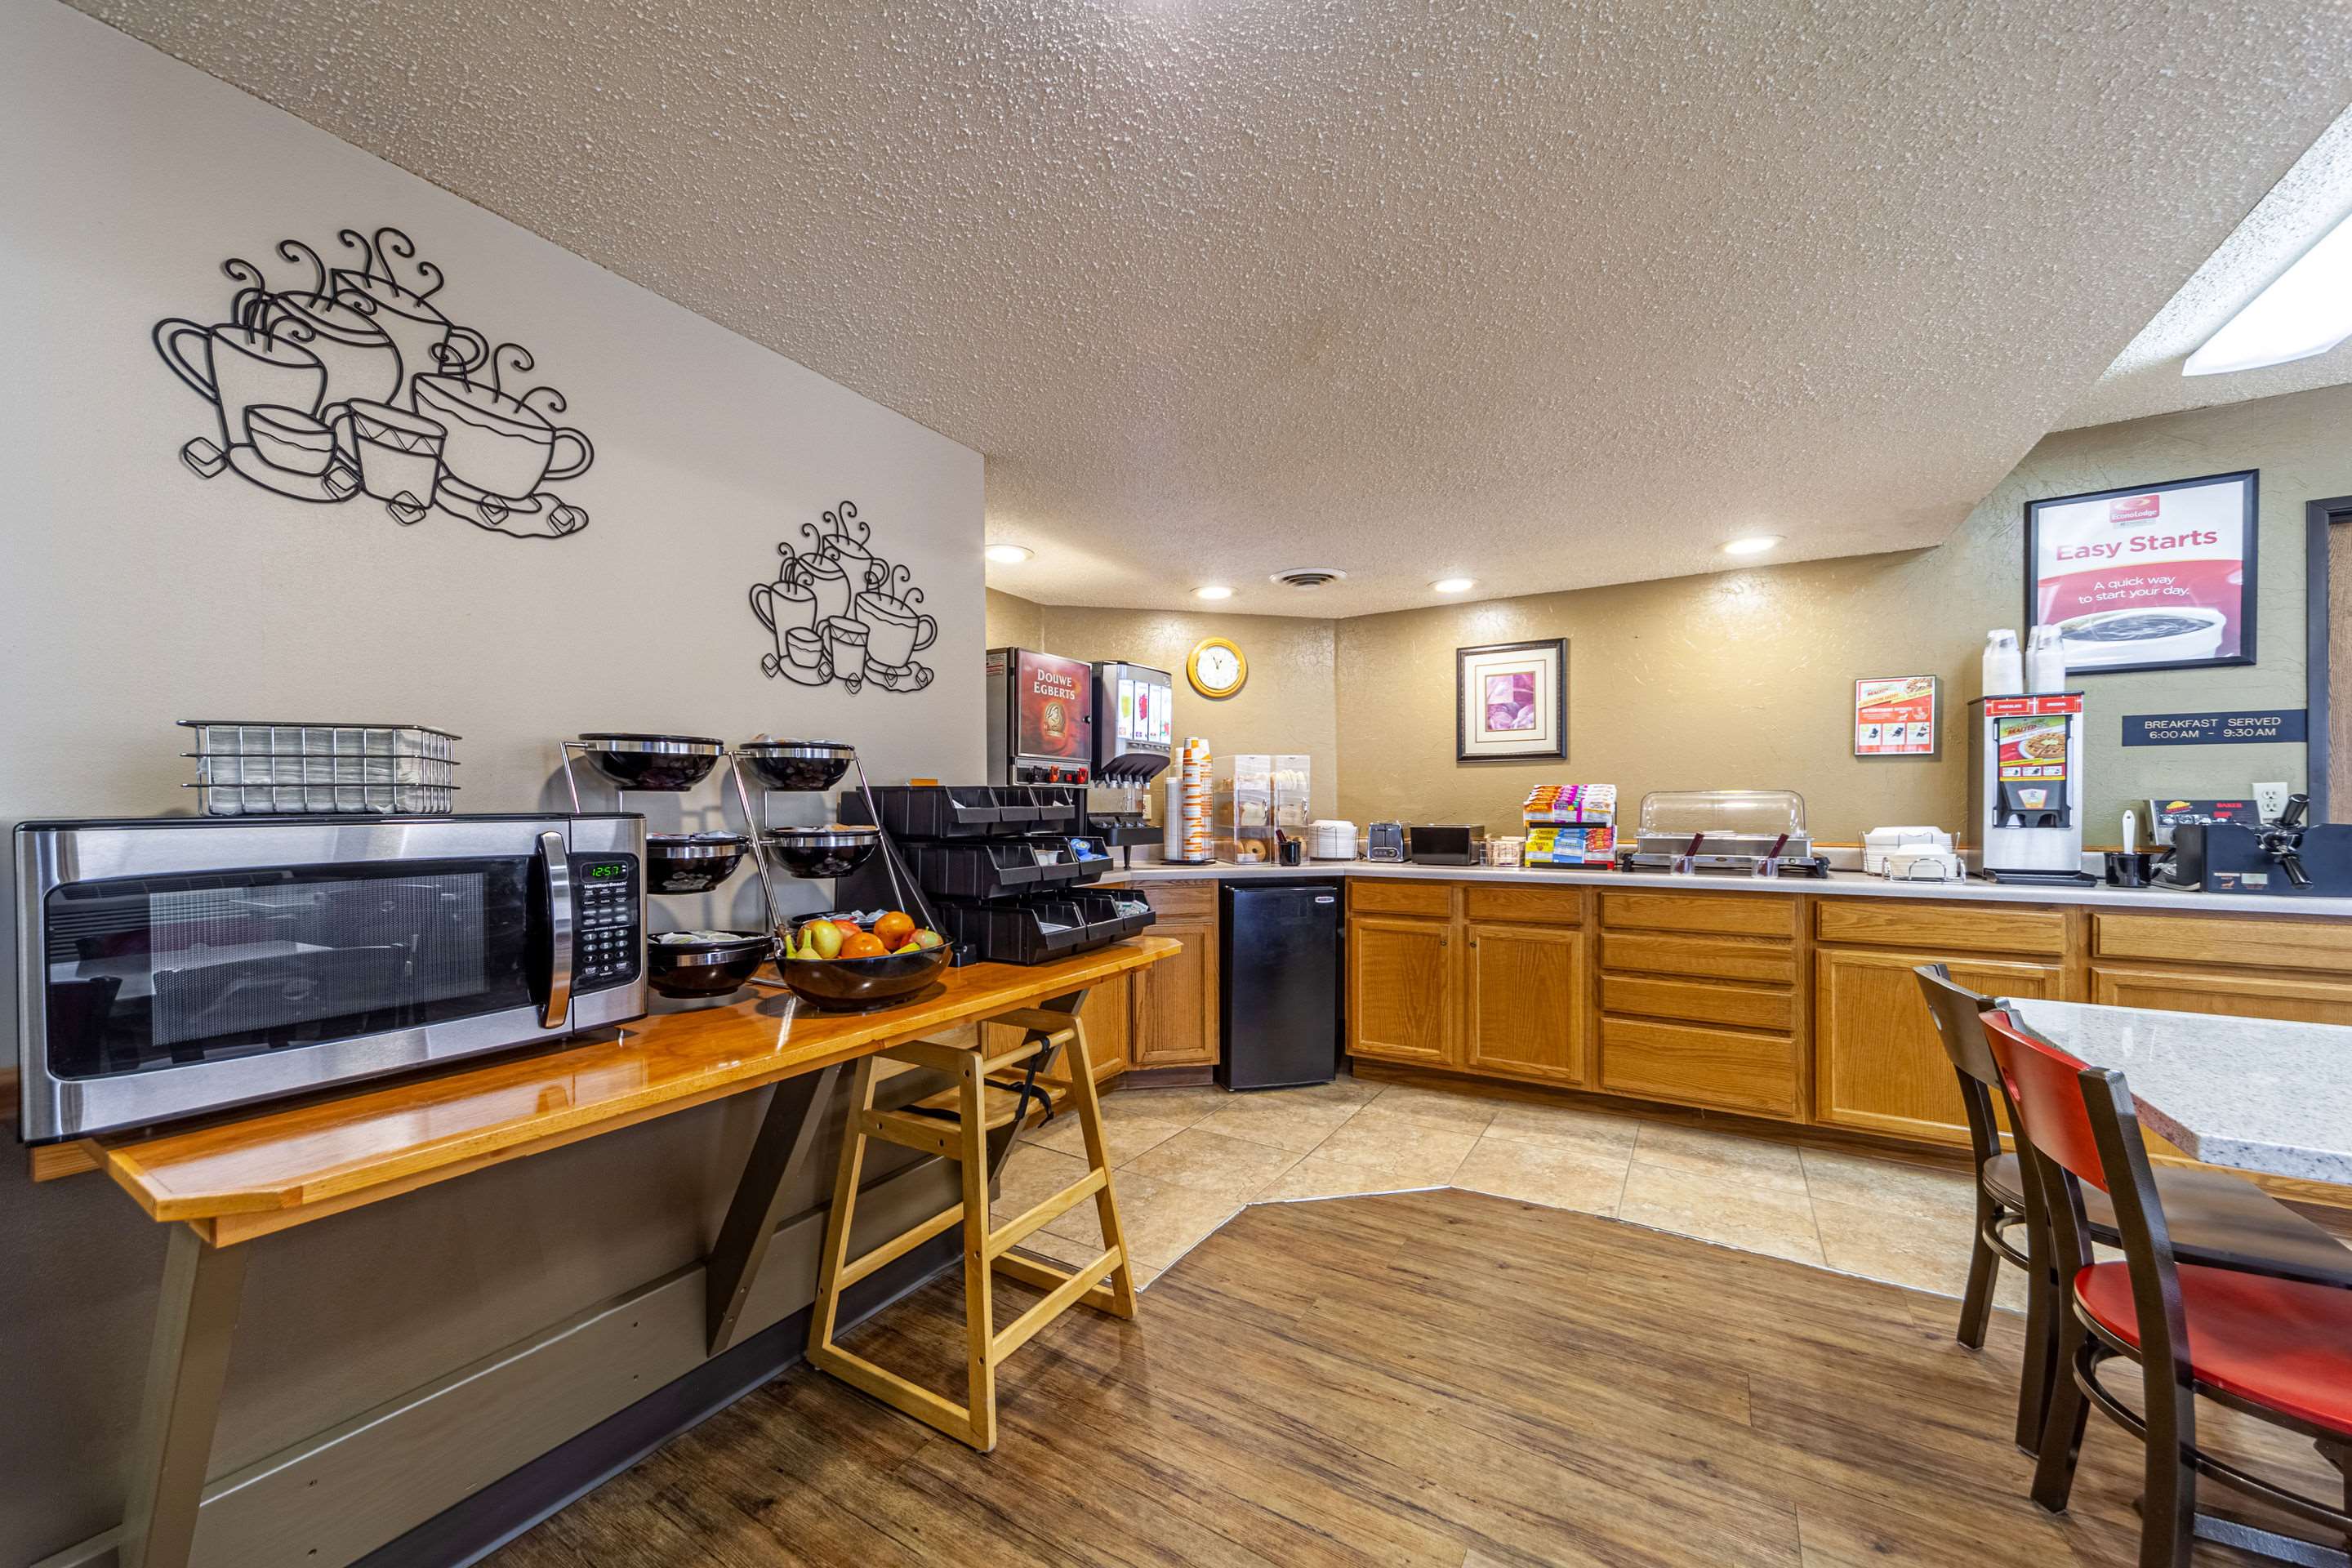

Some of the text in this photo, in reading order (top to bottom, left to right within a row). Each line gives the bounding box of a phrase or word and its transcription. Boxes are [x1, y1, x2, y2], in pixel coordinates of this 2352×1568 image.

[2056, 530, 2218, 561] Easy Starts
[2093, 575, 2176, 590] A quick way
[2078, 585, 2189, 604] to start your day.
[1037, 669, 1072, 687] DOUWE
[1034, 682, 1076, 700] EGBERTS
[2144, 716, 2281, 729] BREAKFAST SERVED
[592, 866, 619, 877] 12:57
